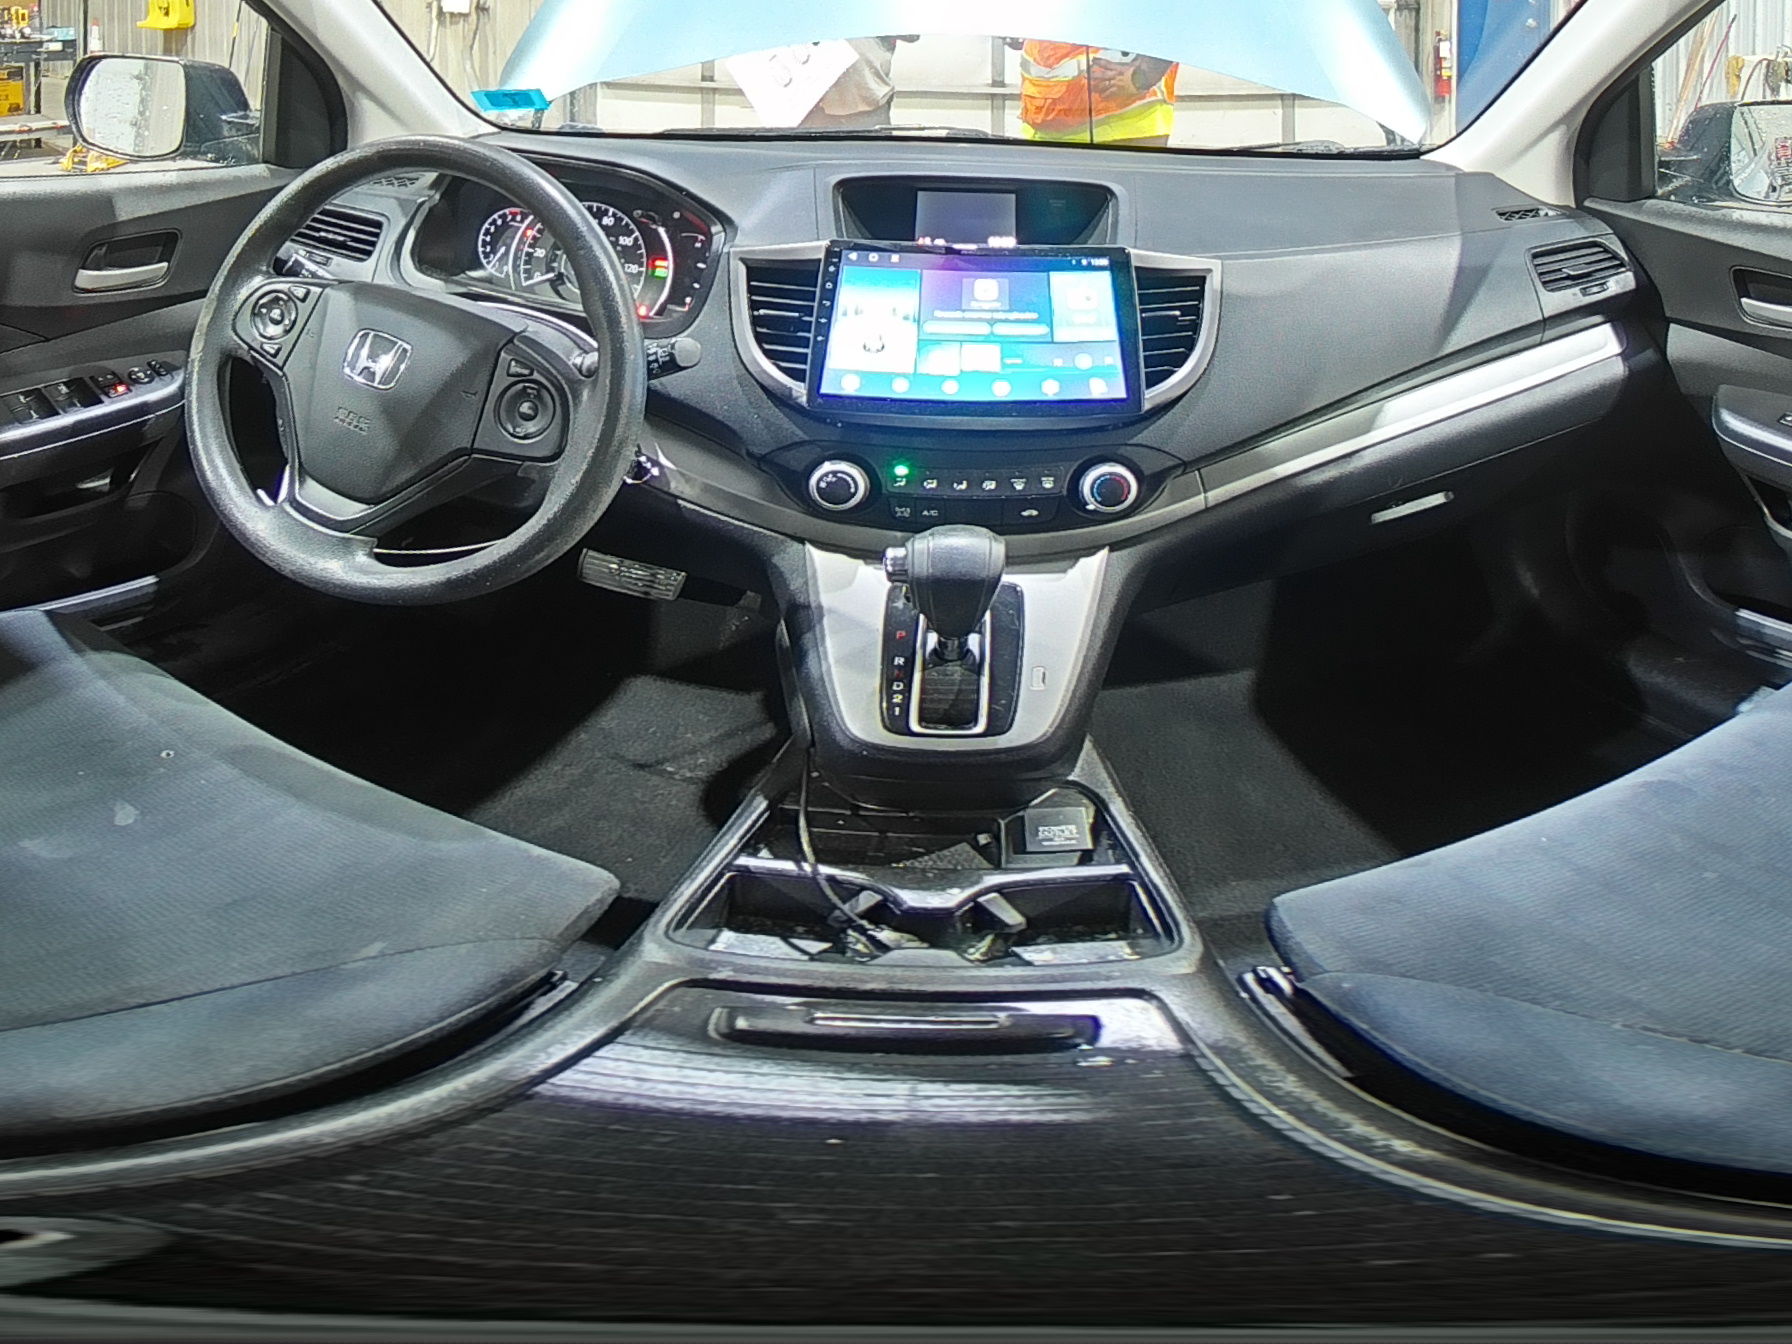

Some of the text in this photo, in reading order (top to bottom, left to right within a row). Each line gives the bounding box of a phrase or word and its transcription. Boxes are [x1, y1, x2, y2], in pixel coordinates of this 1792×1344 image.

[618, 236, 634, 246] 100
[533, 247, 546, 258] 20
[624, 263, 639, 274] 120
[896, 630, 907, 640] P
[893, 656, 905, 666] R
[892, 681, 904, 691] D
[891, 694, 904, 703] 2
[894, 706, 900, 716] 1
